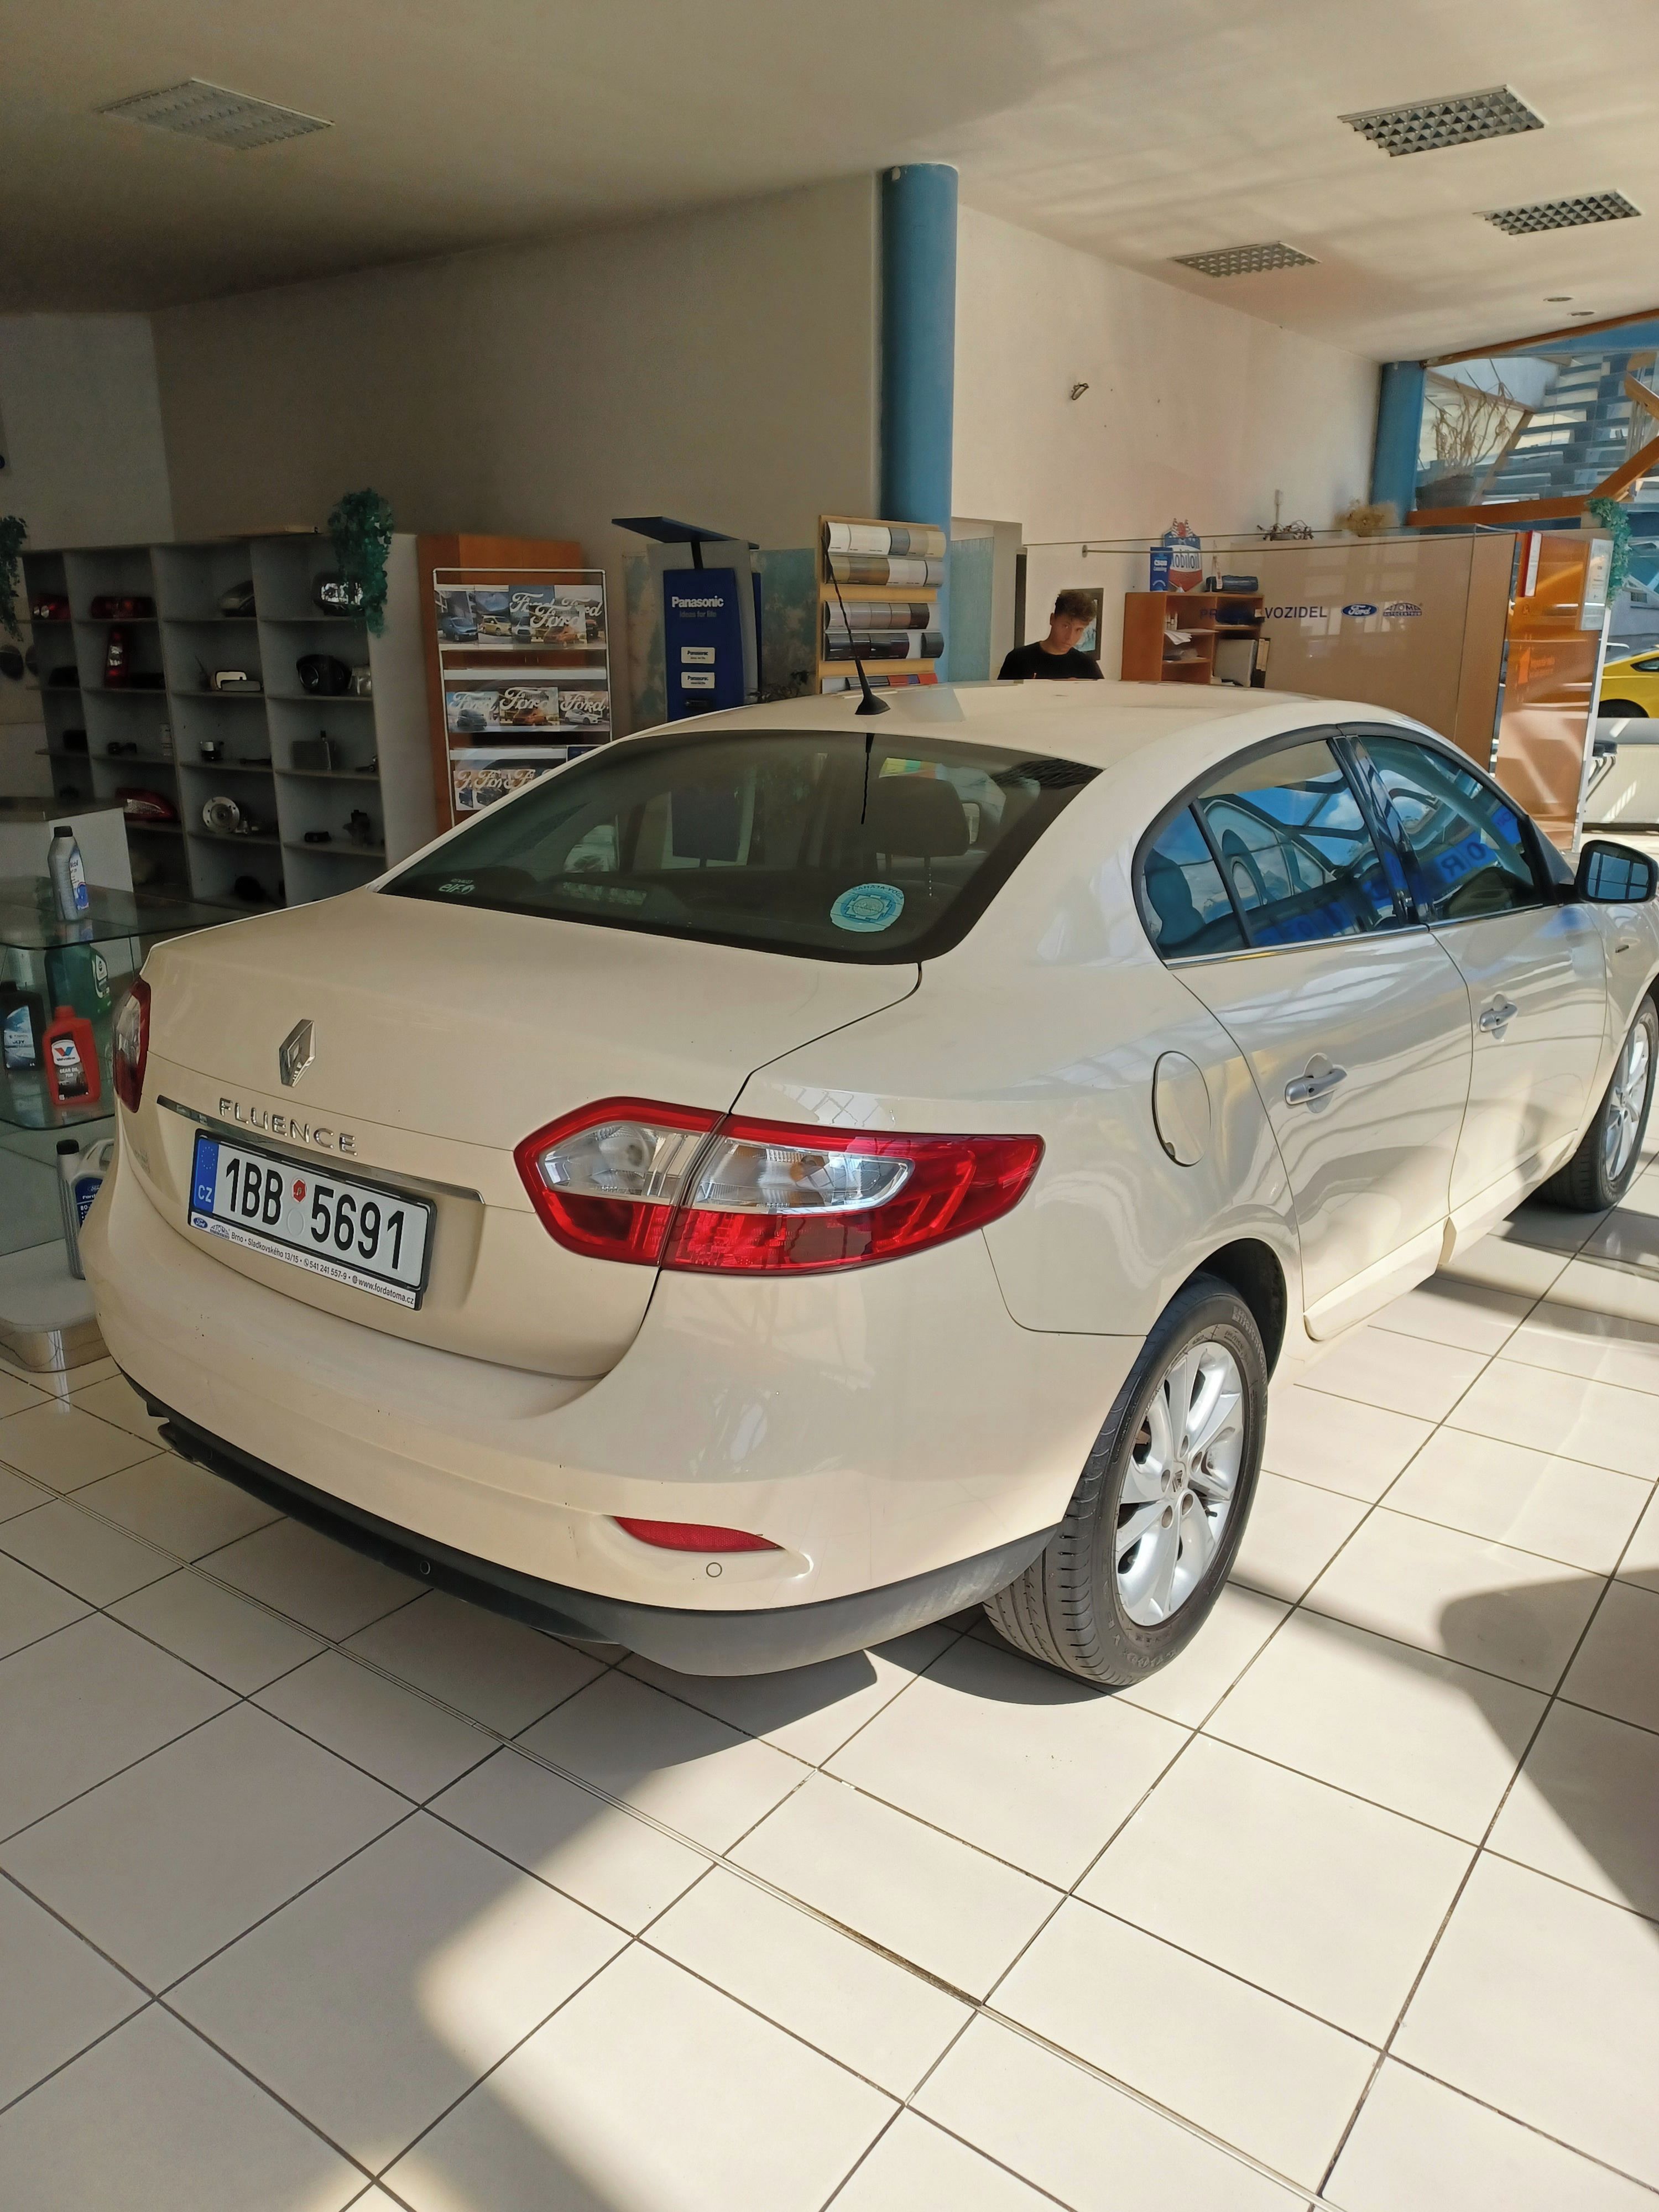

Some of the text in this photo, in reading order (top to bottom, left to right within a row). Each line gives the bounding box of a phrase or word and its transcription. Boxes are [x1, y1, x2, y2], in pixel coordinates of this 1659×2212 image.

[1172, 549, 1200, 569] obiloil
[671, 596, 724, 608] Panasonic
[1265, 606, 1327, 619] VOZIDEL
[220, 1097, 358, 1156] FLUENCE
[197, 1184, 212, 1204] CZ
[226, 1157, 404, 1271] 1BB 5691
[231, 1232, 414, 1305] Brno Sladkovského 13/15 541 241 557-9 www.fordatoma.cz
